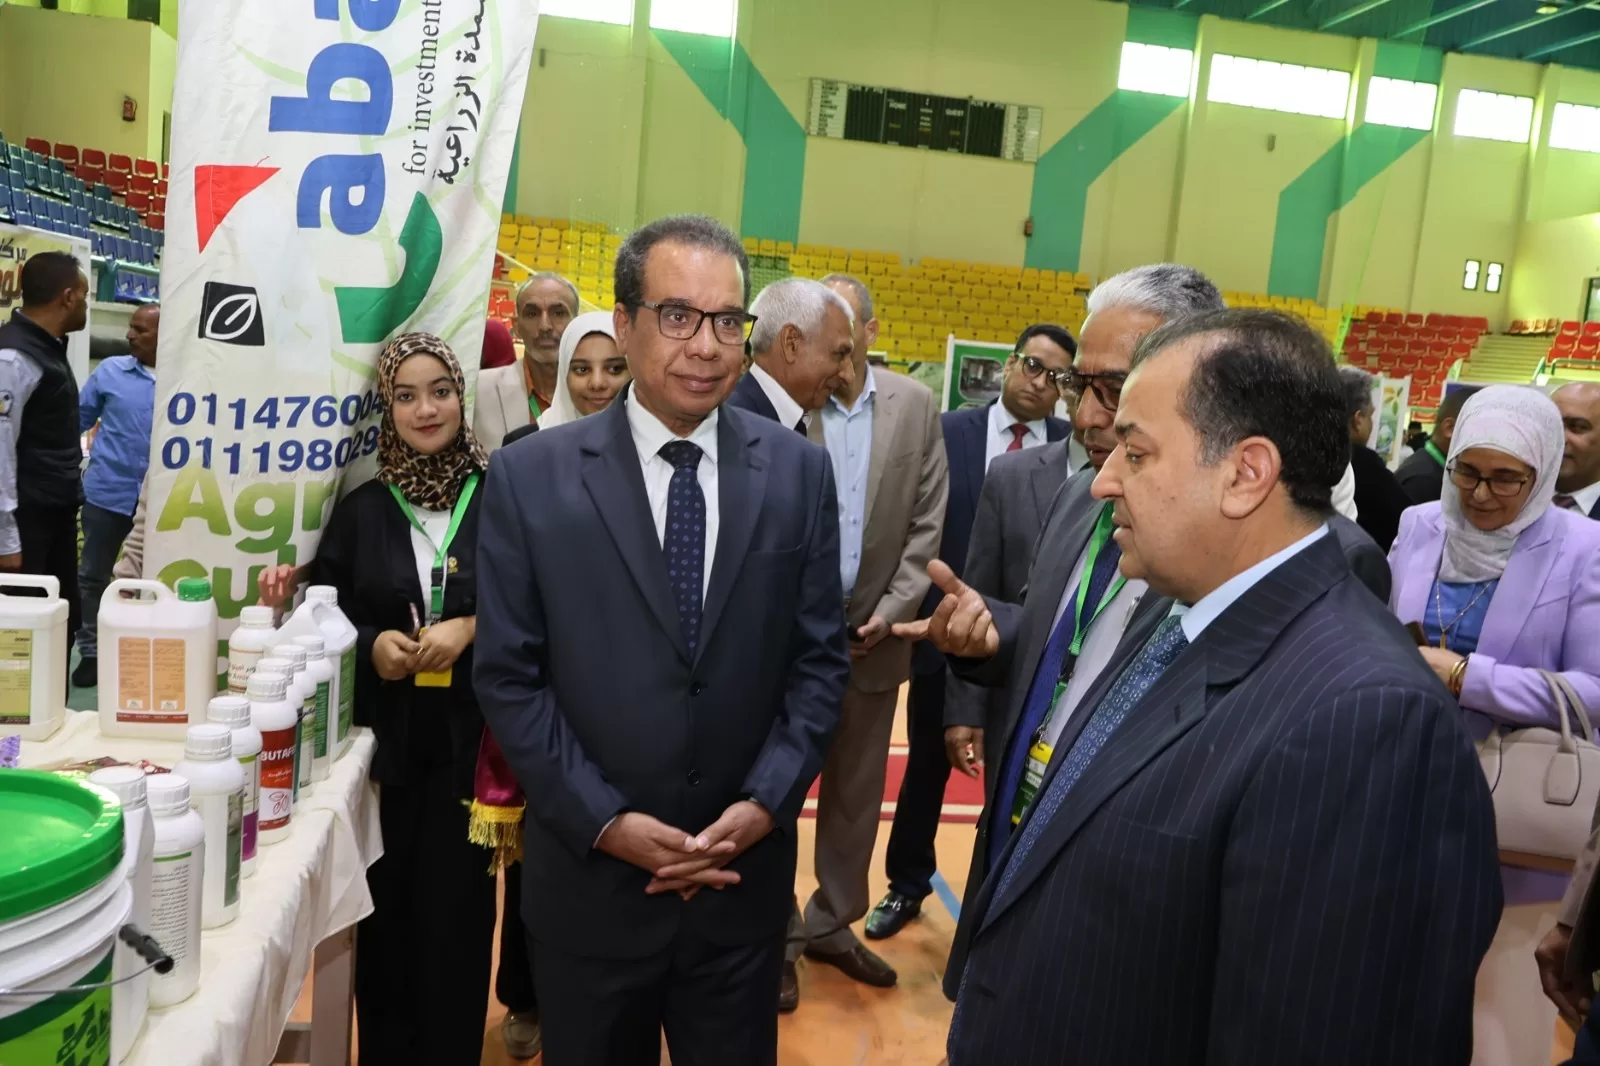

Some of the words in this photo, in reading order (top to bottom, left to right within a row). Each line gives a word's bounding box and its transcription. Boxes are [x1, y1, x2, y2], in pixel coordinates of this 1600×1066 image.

[408, 0, 442, 132] investment
[402, 139, 427, 175] for
[432, 75, 481, 185] الزراعية
[167, 390, 383, 430] 011476004
[161, 425, 379, 475] 011198029
[155, 464, 342, 554] Agr
